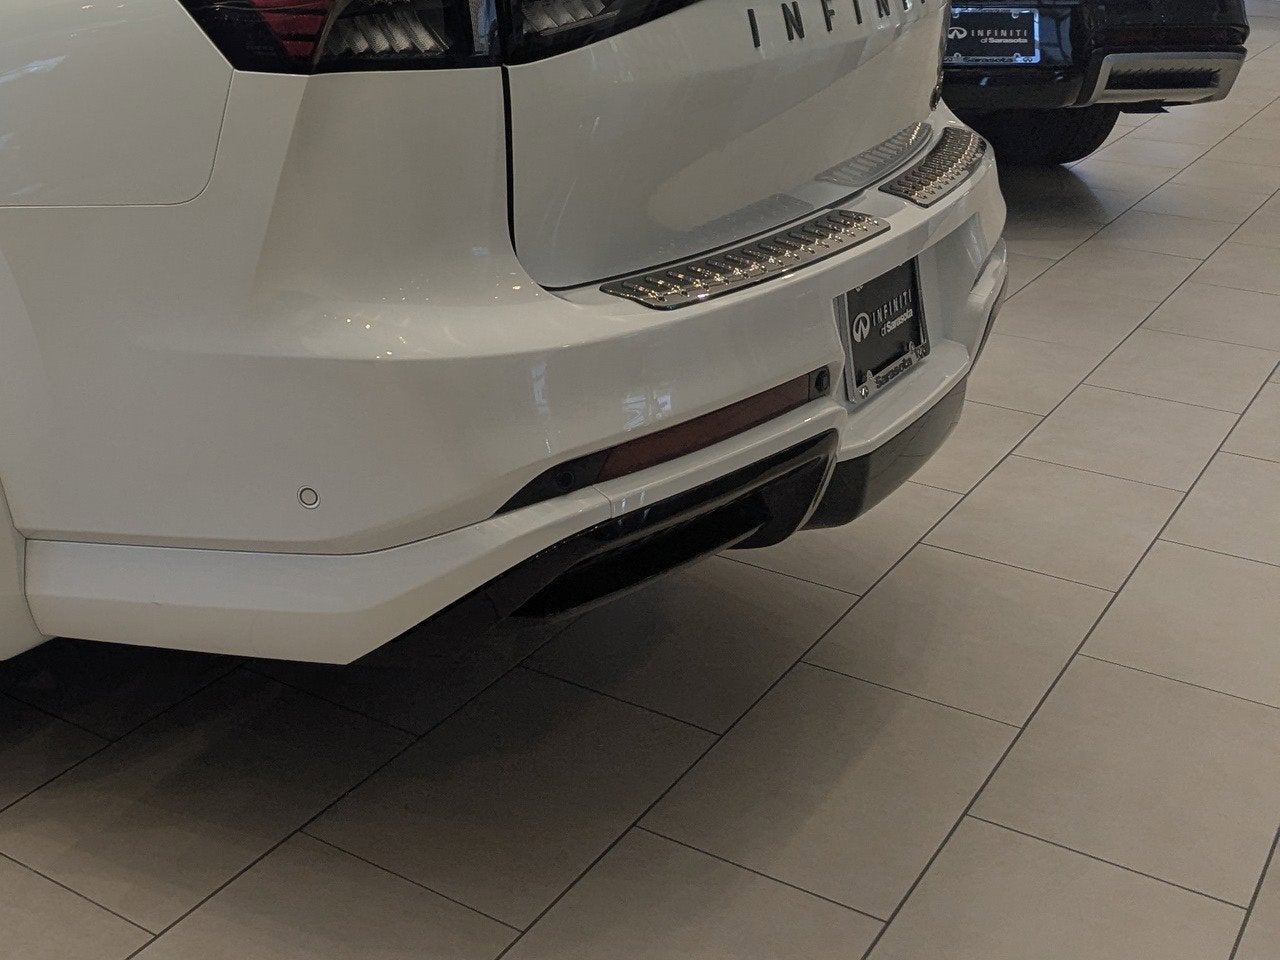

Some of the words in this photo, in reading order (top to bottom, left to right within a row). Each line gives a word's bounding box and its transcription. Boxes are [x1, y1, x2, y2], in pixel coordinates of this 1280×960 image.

[970, 28, 1028, 37] INFINITI
[871, 289, 912, 327] INFINITI
[886, 308, 914, 333] Sarasota
[874, 357, 913, 389] Sarasota
